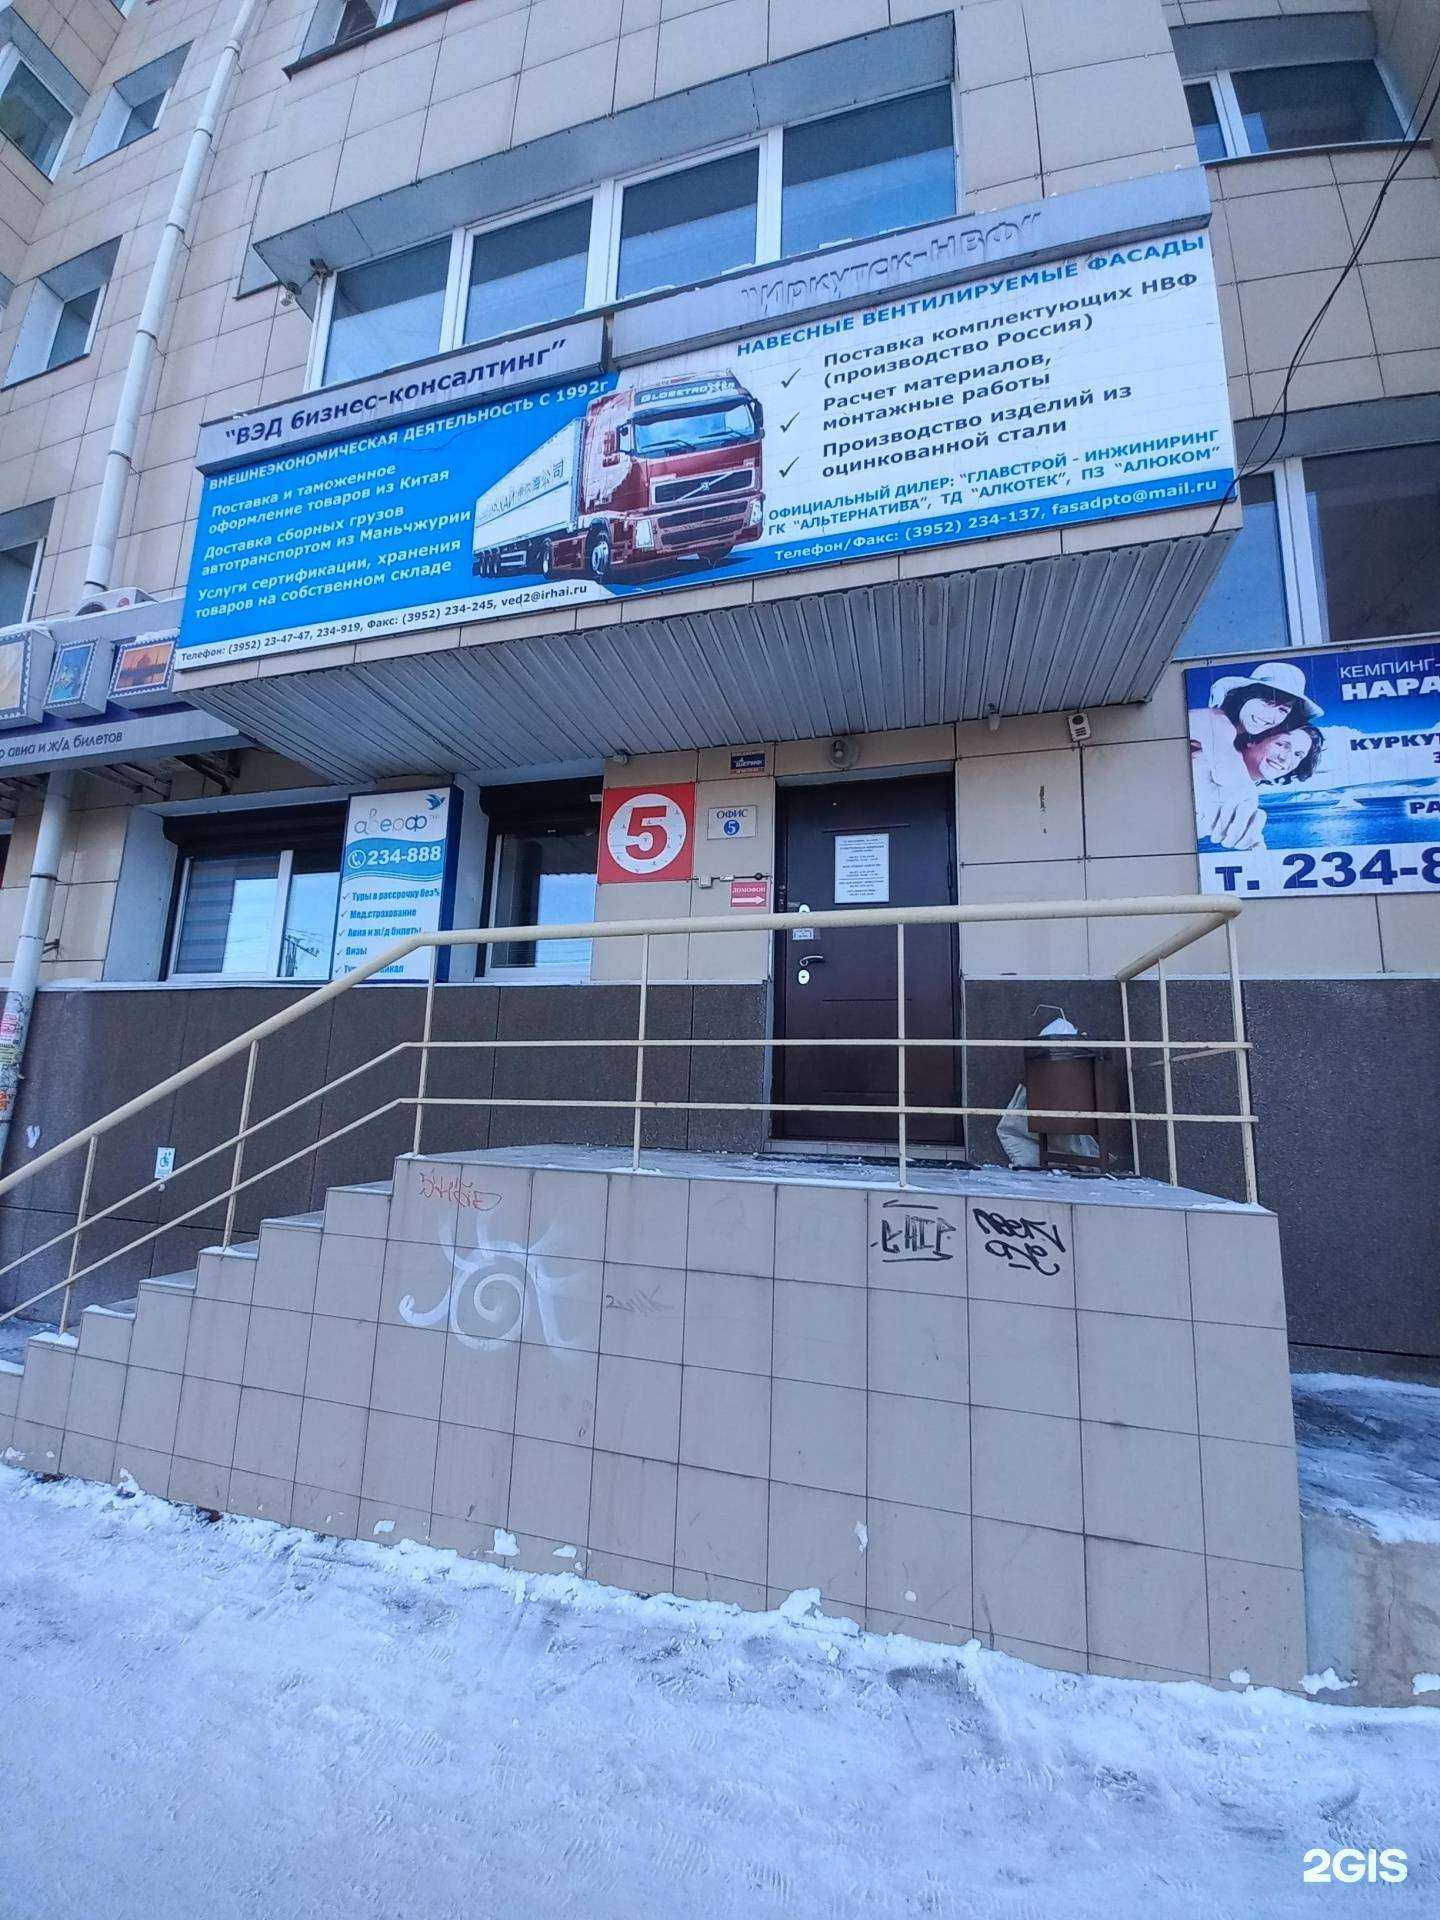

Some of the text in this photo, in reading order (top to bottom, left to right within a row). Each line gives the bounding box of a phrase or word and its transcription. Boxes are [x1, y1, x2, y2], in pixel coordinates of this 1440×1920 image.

[737, 236, 1204, 357] НАВЕСНЫЕ ВЕНТИЛИРУЕМЫЕ ФАСАДЫ
[823, 273, 1198, 368] Поставка комплектующих НВФ
[823, 353, 1051, 411] Расчет материалов,
[824, 313, 1093, 389] (производство Россия)
[823, 373, 1050, 431] монтажные работы
[823, 386, 1133, 457] Производство изделий из
[209, 381, 609, 491] ВНЕШНЕЭКОНОМИЧЕСКАЯ ДЕЯТЕЛЬНОСТЬ С 1992г
[822, 420, 1067, 478] оцинкованной стали
[208, 469, 450, 535] оформление товаров из Китая
[211, 464, 396, 517] Поставка и таможенное
[768, 485, 890, 521] ОФИЦИАЛЬНЫЙ
[895, 476, 954, 498] ДИЛЕР:
[1084, 429, 1220, 463] ИНЖИНИРИНГ
[768, 523, 786, 536] ГК
[941, 491, 963, 505] ТД
[1081, 466, 1105, 481] ПЗ
[201, 510, 471, 576] автотранспортом из Маньчжурии
[203, 505, 405, 561] Доставка сборных грузов
[774, 479, 1217, 561] Телефон/Факс: (3952) 234-137, fasadpto@mail.ru
[195, 560, 452, 618] товаров на собственном складе
[198, 538, 461, 602] Услуги сертификации, хранения
[181, 585, 587, 661] Телефон: (3952) 23-47-47, 234-919, Факс: (3952) 234-245, ved2@irhai.ru
[73, 732, 122, 748] билетов
[625, 805, 667, 860] 5
[716, 808, 749, 820] ОФИС
[727, 821, 738, 836] 5
[367, 845, 441, 866] 234-888
